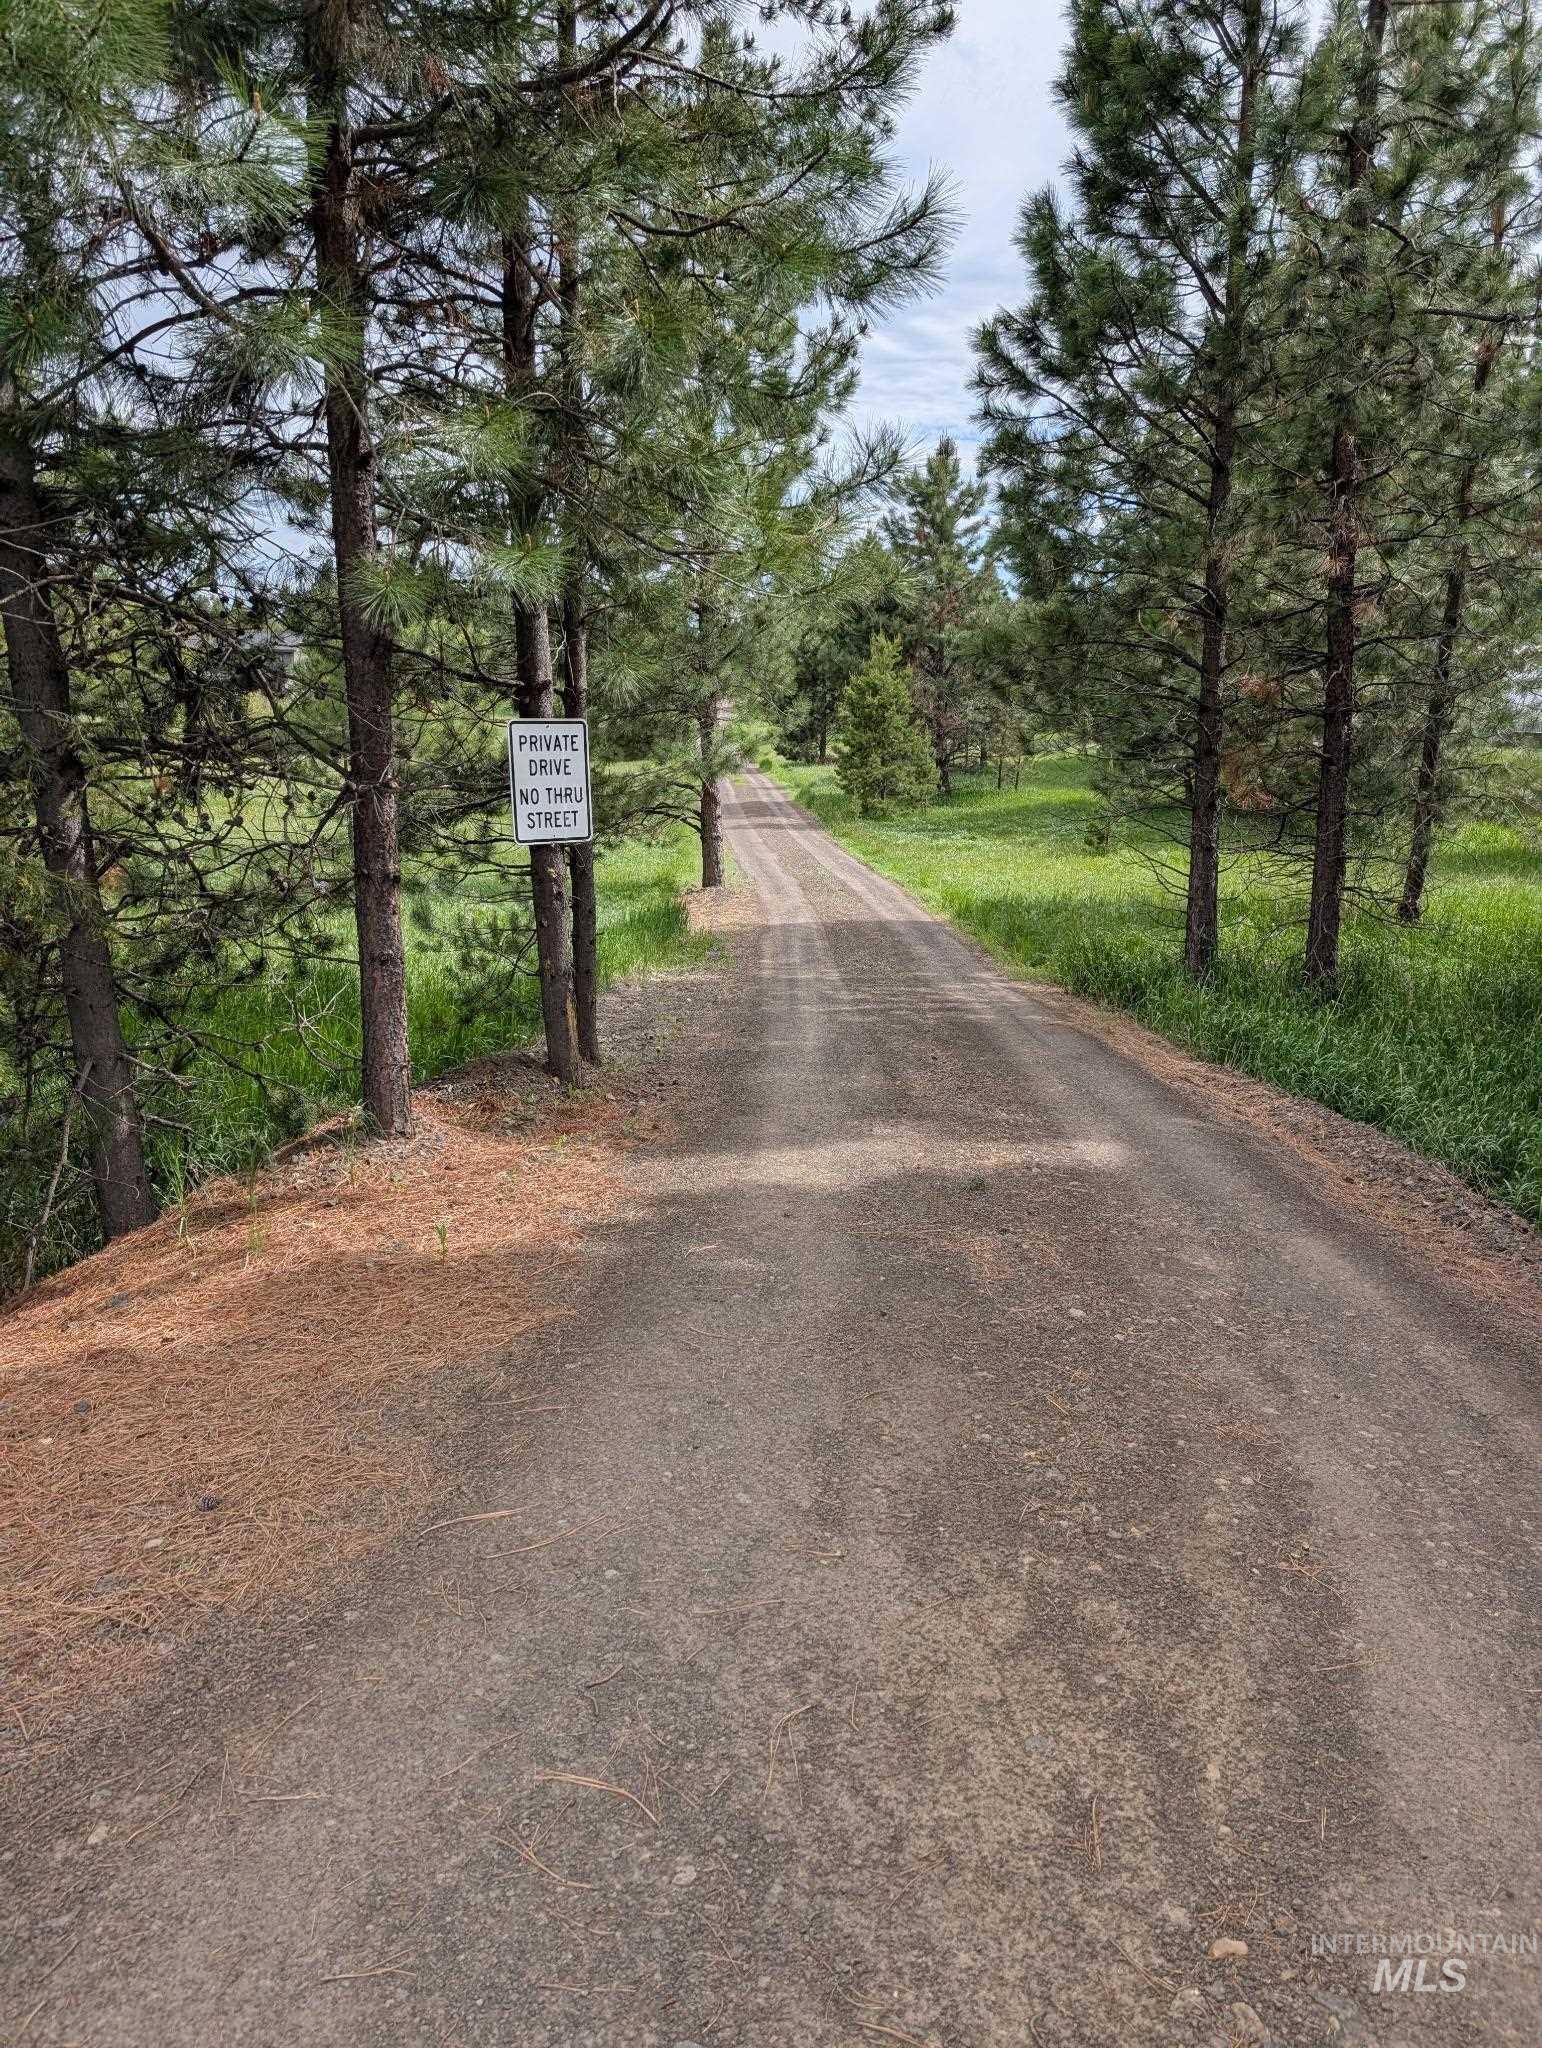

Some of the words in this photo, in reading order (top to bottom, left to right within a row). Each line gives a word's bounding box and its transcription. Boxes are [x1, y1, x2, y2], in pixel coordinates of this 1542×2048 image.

[519, 735, 579, 752] PRIVATE
[529, 759, 572, 776] DRIVE
[520, 788, 539, 805] NO
[545, 787, 583, 804] THRU
[527, 810, 579, 829] STREET
